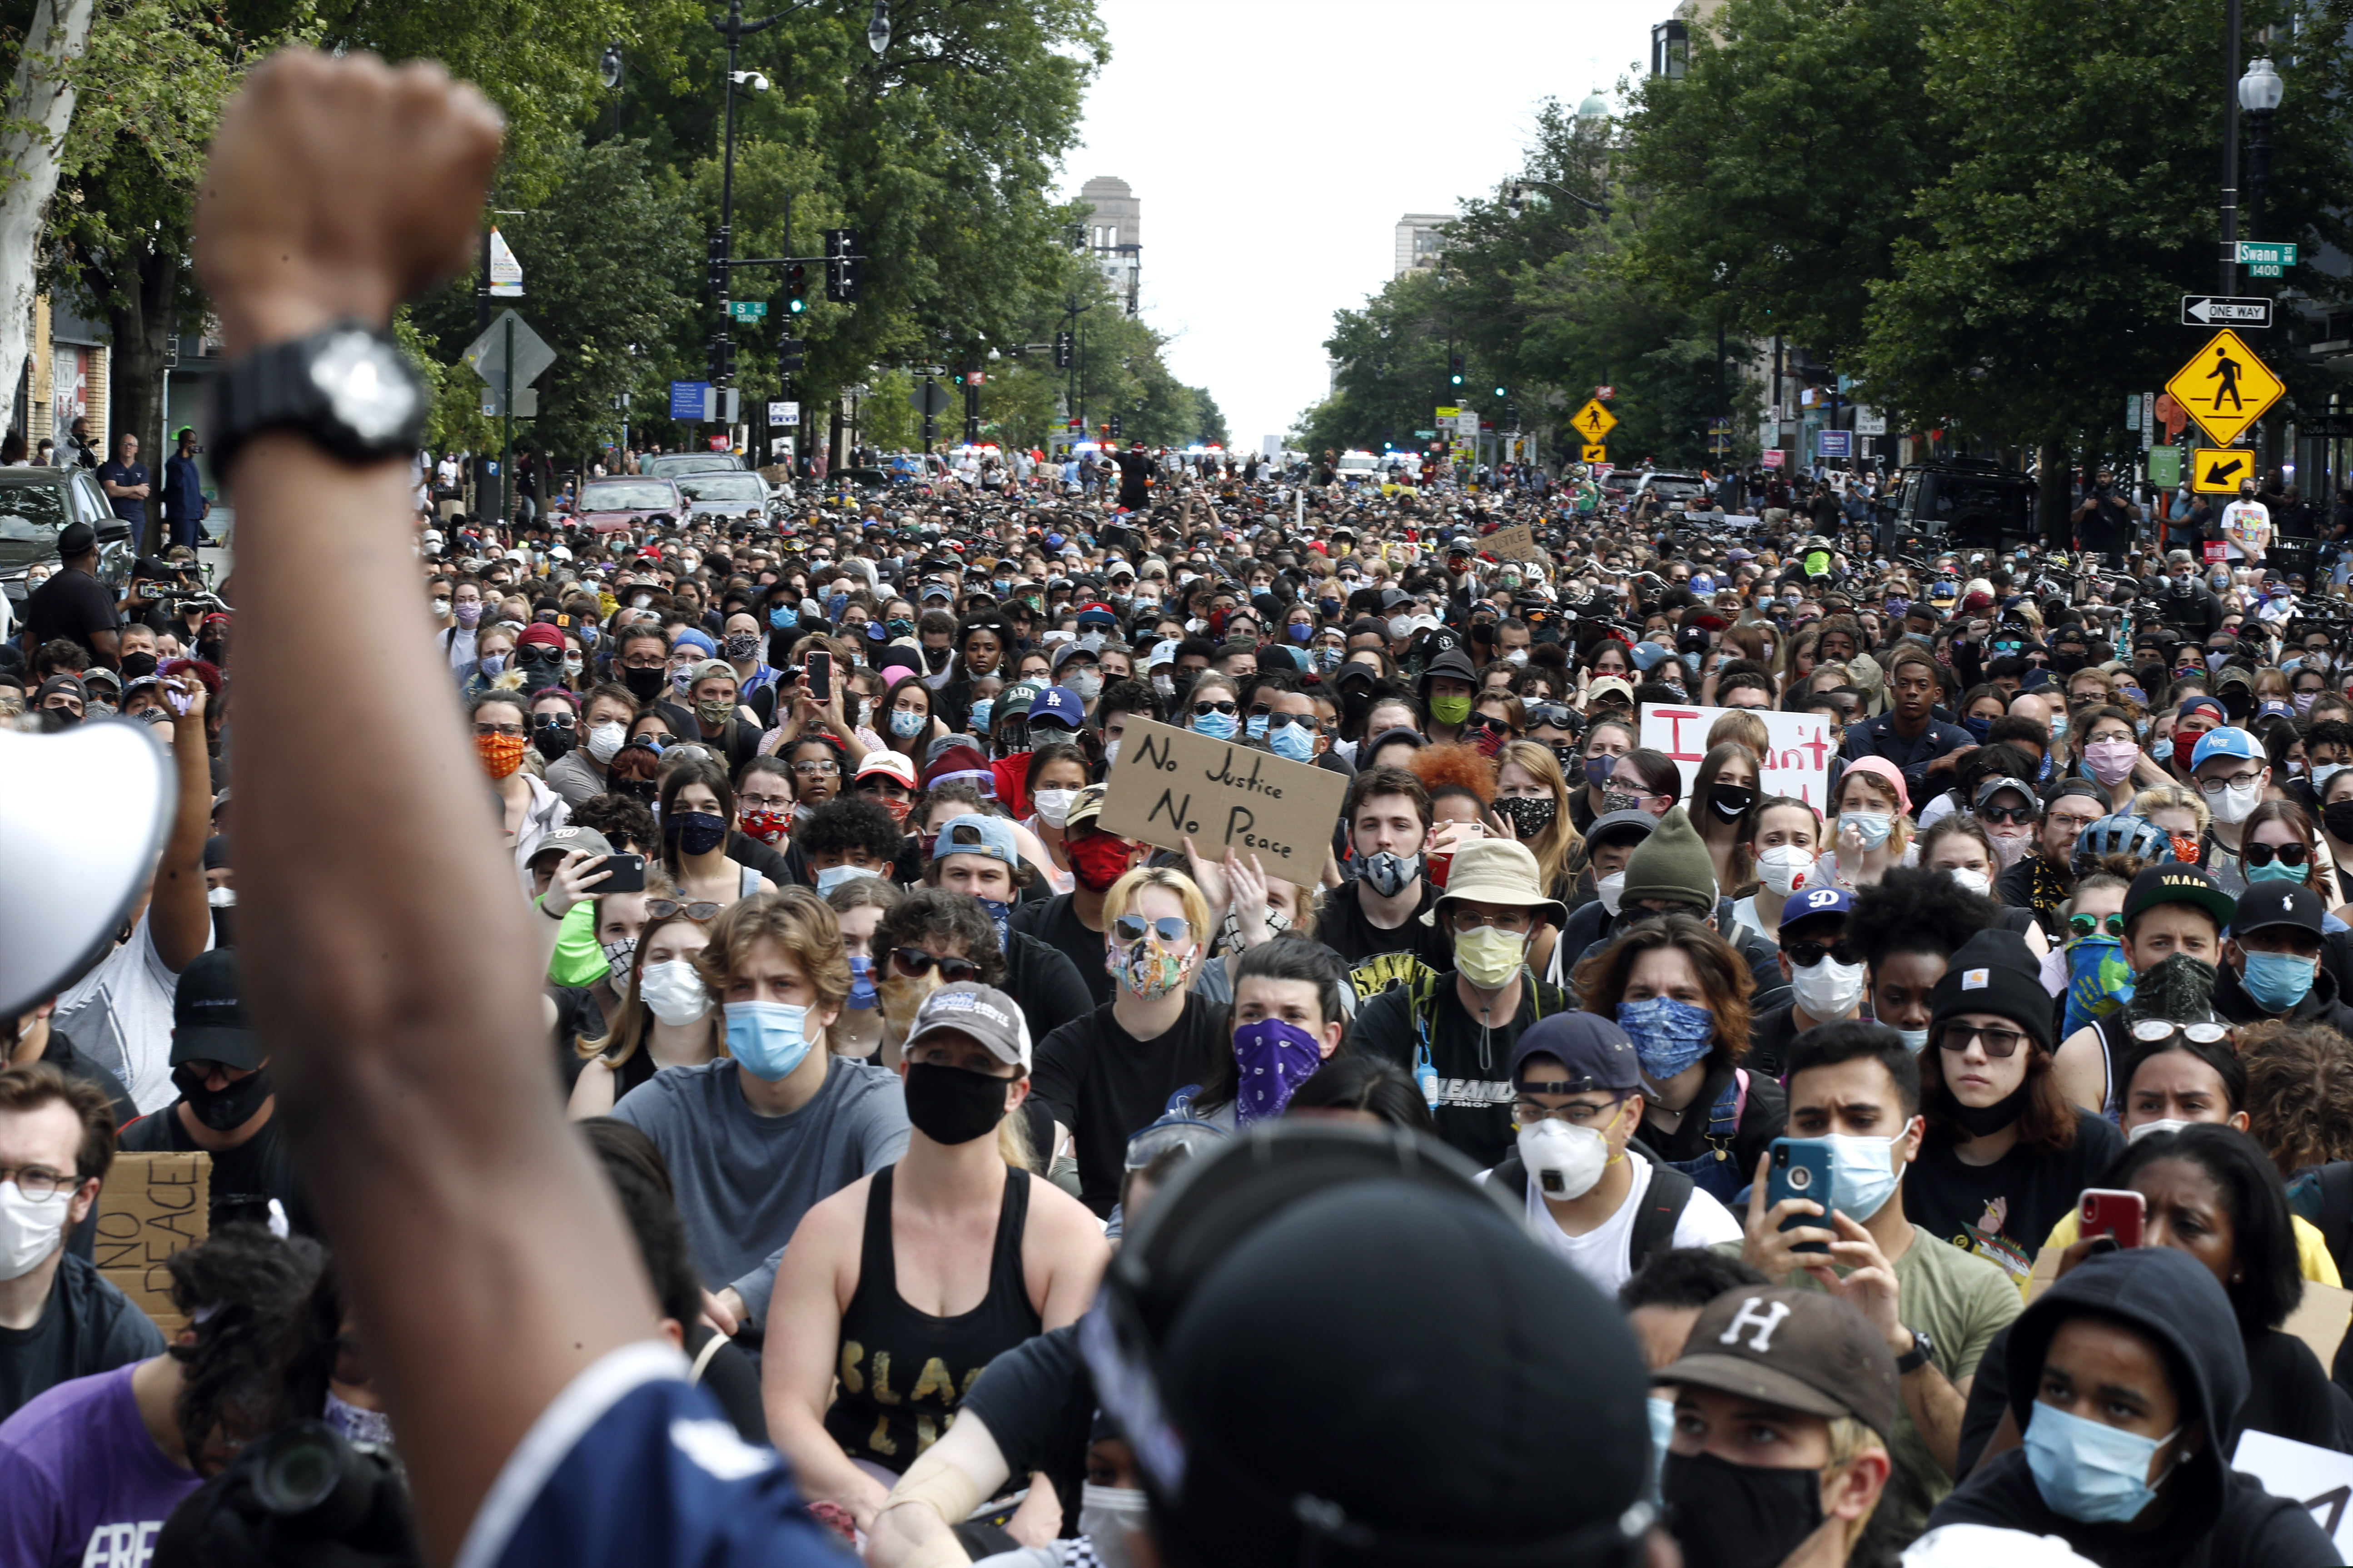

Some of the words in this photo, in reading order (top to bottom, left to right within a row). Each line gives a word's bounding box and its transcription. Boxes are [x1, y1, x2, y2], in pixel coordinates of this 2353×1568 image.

[2241, 245, 2278, 262] Swann
[2283, 246, 2293, 254] ST
[2253, 265, 2280, 276] 1400
[736, 303, 746, 313] S
[2209, 305, 2233, 317] ONE
[2237, 306, 2262, 318] WAY
[1489, 530, 1527, 550] JUSTICE
[1046, 690, 1062, 706] LA
[1652, 709, 1703, 762] I
[1132, 733, 1177, 772] No
[1205, 747, 1283, 799] Justice
[1147, 788, 1199, 834] No
[1225, 805, 1293, 858] Peace
[1808, 889, 1840, 908] D
[1452, 1100, 1492, 1108] SHOP
[94, 1212, 142, 1269] NO
[1719, 1297, 1791, 1353] H
